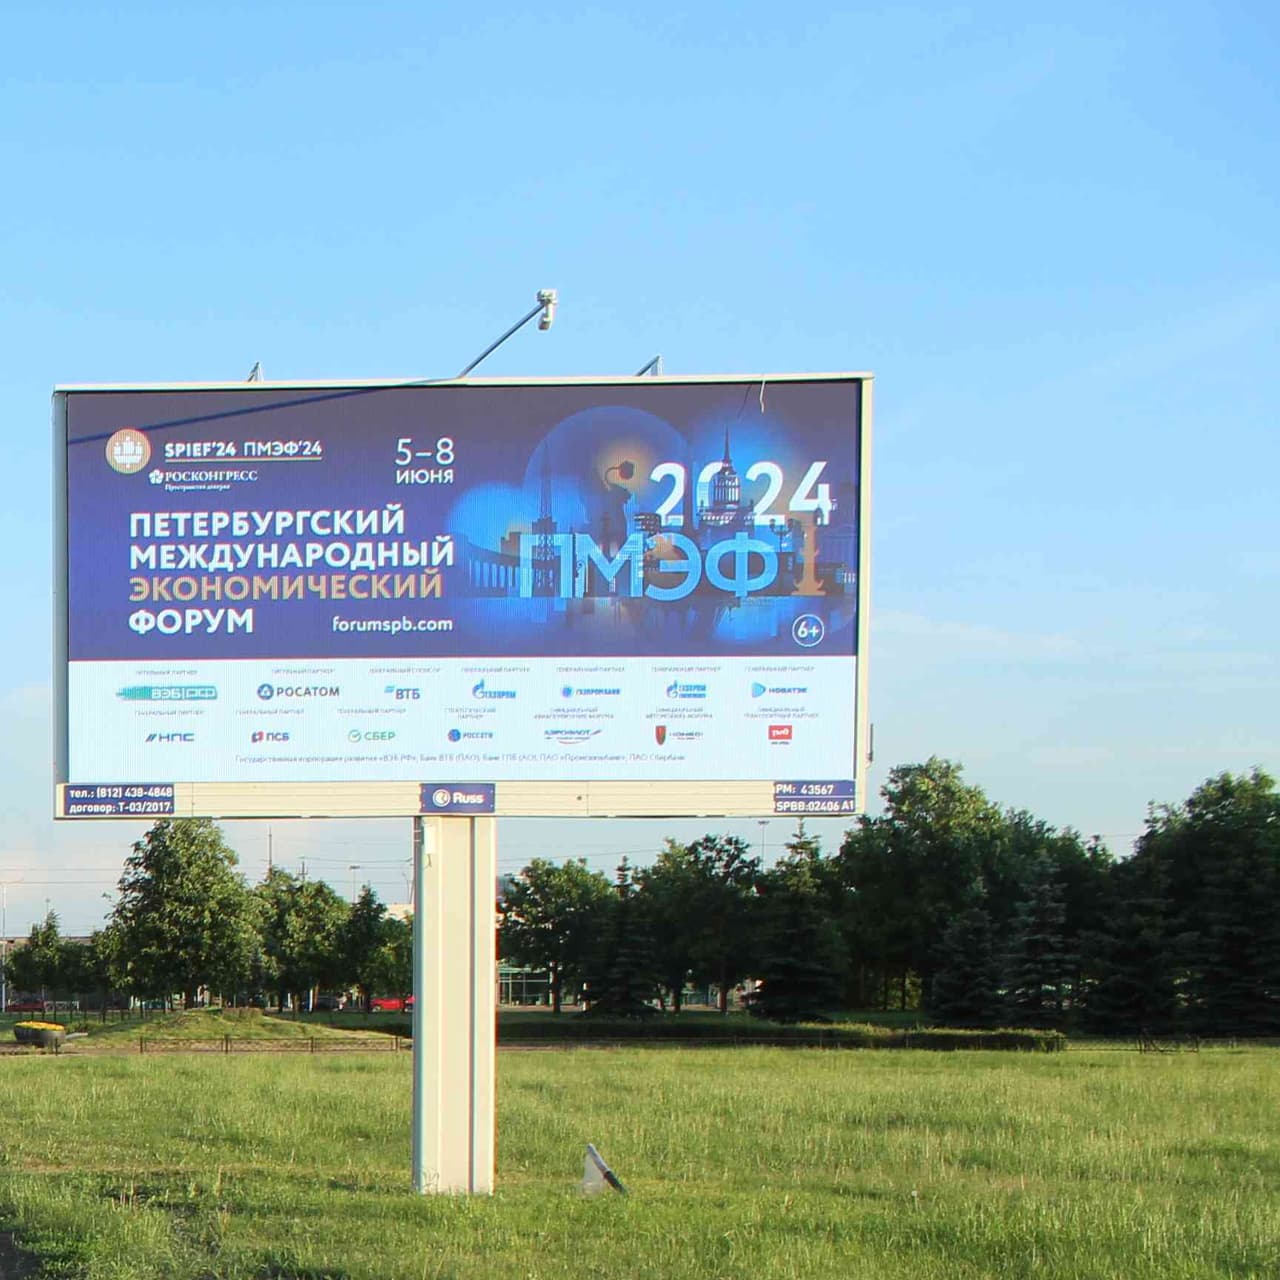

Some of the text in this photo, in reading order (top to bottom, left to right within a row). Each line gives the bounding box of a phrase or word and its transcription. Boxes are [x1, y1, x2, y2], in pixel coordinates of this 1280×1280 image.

[164, 469, 259, 482] РОСКОНГРЕСС
[395, 468, 454, 484] ИЮНЯ
[129, 503, 405, 538] ПЕТЕРБУРГСКИЙ
[129, 535, 455, 573] МЕЖДУНАРОДНЫЙ
[128, 568, 443, 602] ЭКОНОМИЧЕСКИЙ
[128, 608, 255, 635] ФОРУМ
[331, 615, 454, 635] forumspb.com
[796, 621, 821, 640] 6+
[276, 686, 340, 698] РОСАТОМ
[395, 688, 421, 700] ВТБ
[266, 731, 290, 742] ПСБ
[364, 730, 396, 741] СБЕР
[69, 789, 95, 798] тел.:
[96, 787, 123, 799] (812)
[800, 785, 835, 795] 43567
[453, 791, 485, 804] Russ
[69, 804, 117, 815] договор:
